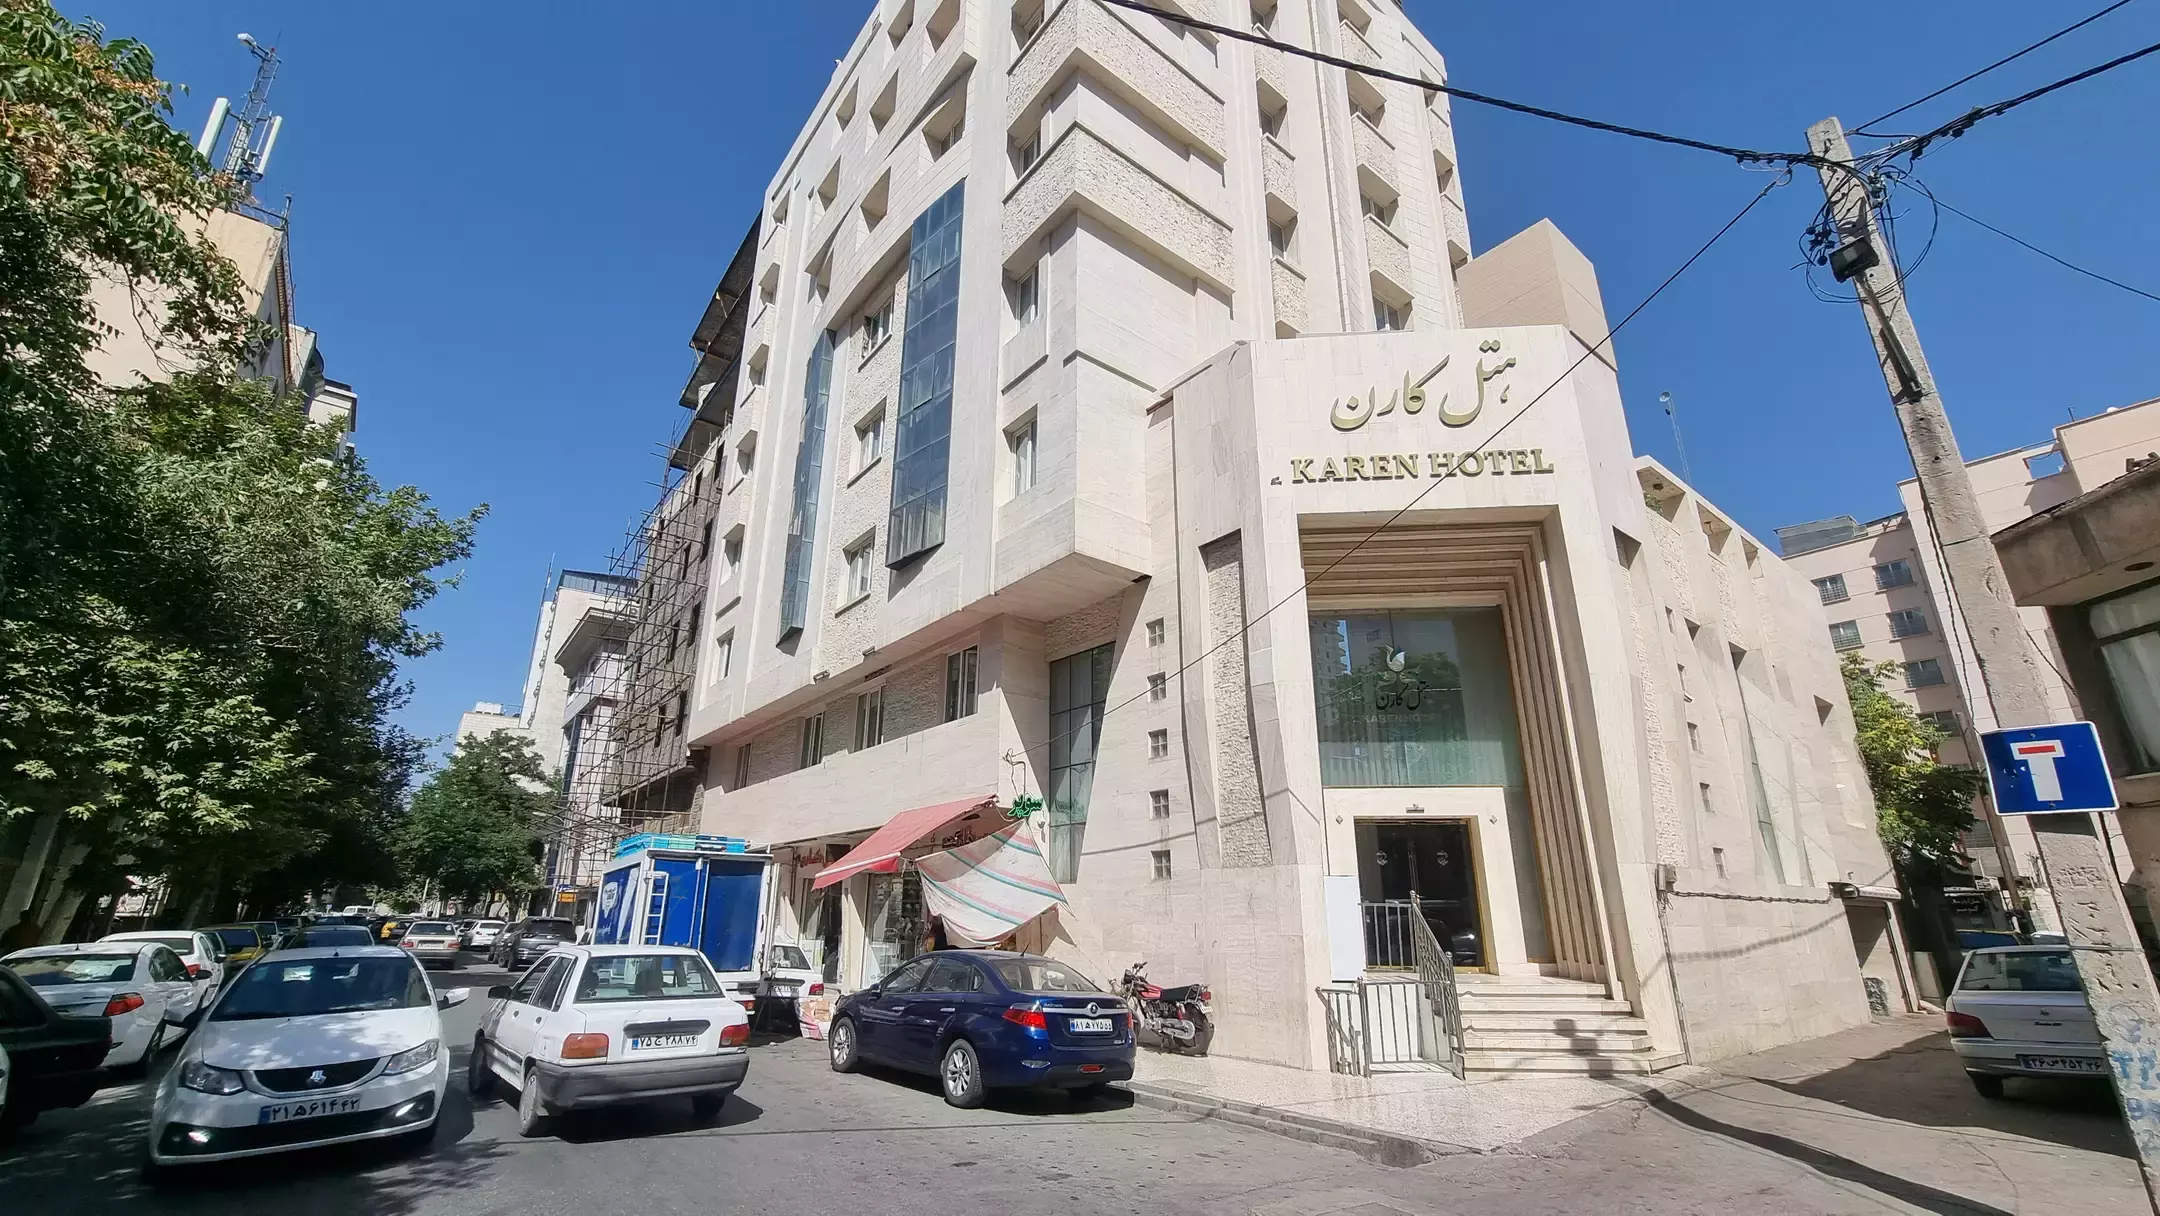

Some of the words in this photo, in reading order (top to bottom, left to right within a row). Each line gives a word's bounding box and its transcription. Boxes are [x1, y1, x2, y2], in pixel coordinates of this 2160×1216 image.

[1330, 354, 1450, 431] کارن
[1439, 339, 1516, 427] هتل
[1291, 453, 1419, 484] KAREN
[1427, 448, 1554, 478] HOTEL
[1007, 794, 1043, 817] سوپر
